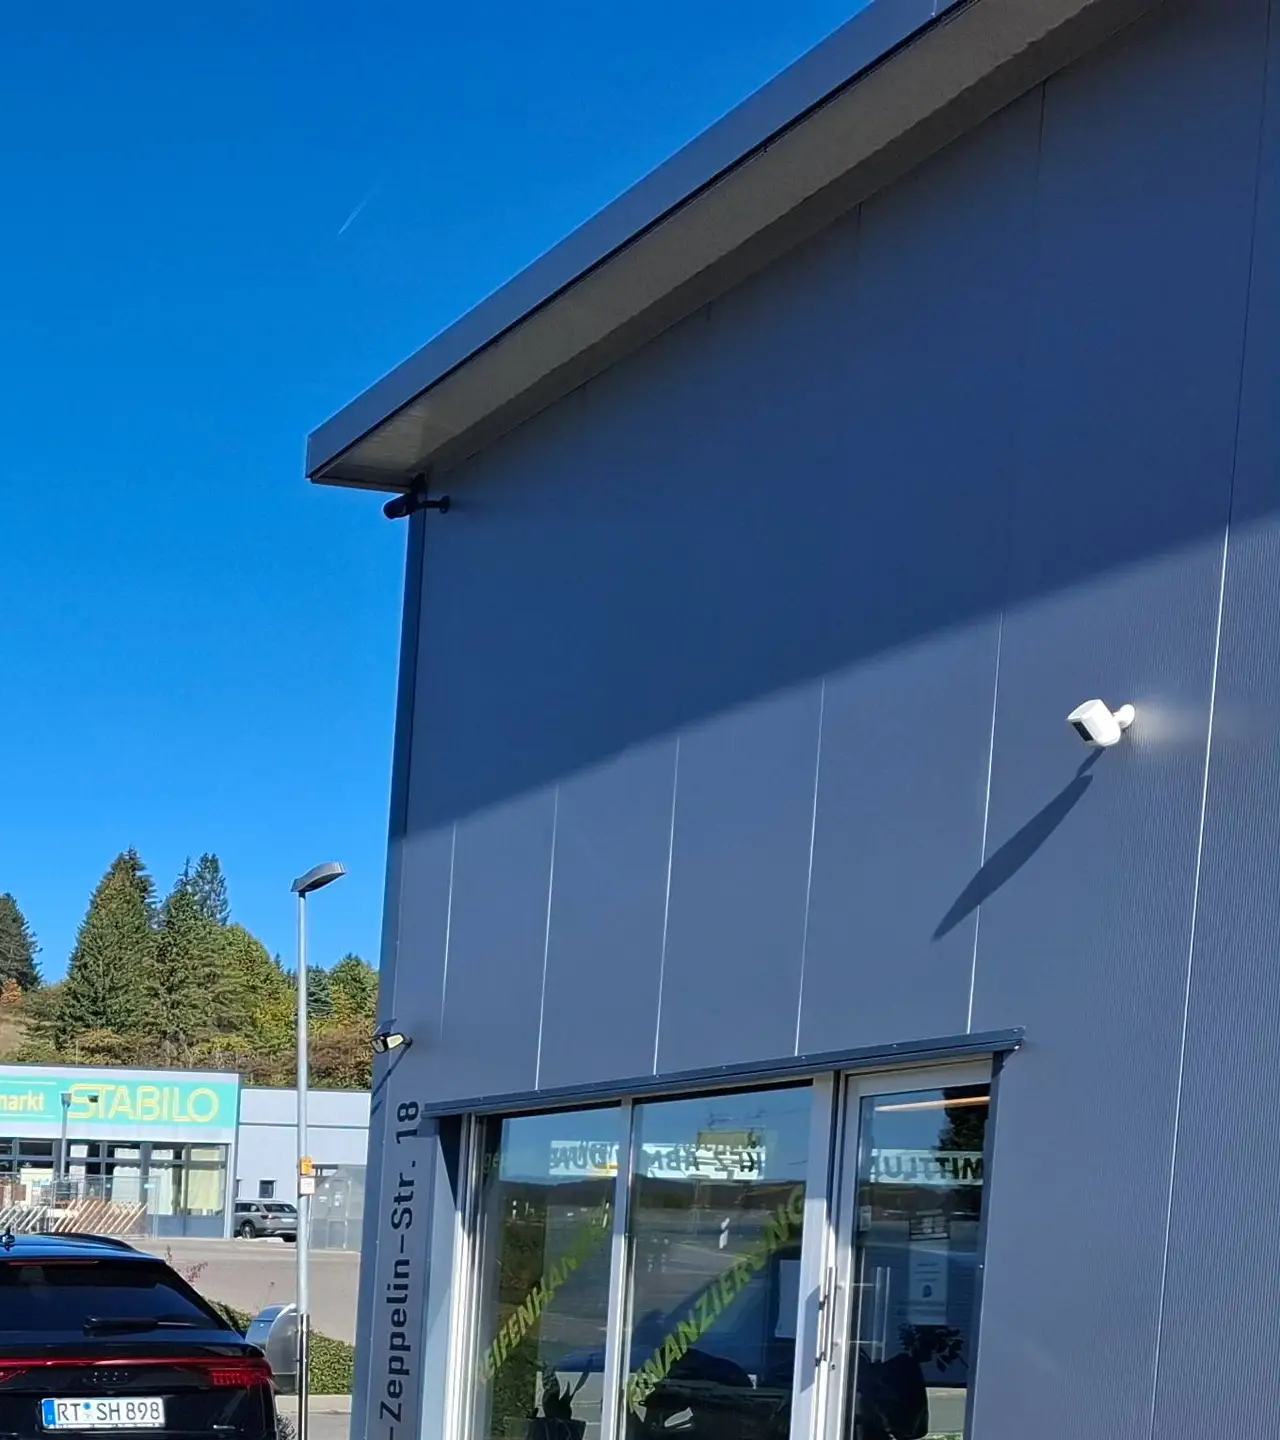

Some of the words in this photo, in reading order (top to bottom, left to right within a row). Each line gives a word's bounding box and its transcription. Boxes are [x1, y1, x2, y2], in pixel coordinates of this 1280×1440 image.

[68, 1083, 219, 1123] STABILO
[396, 1100, 421, 1145] 18
[57, 1403, 81, 1422] RT
[96, 1402, 121, 1421] SH
[126, 1401, 160, 1421] 898
